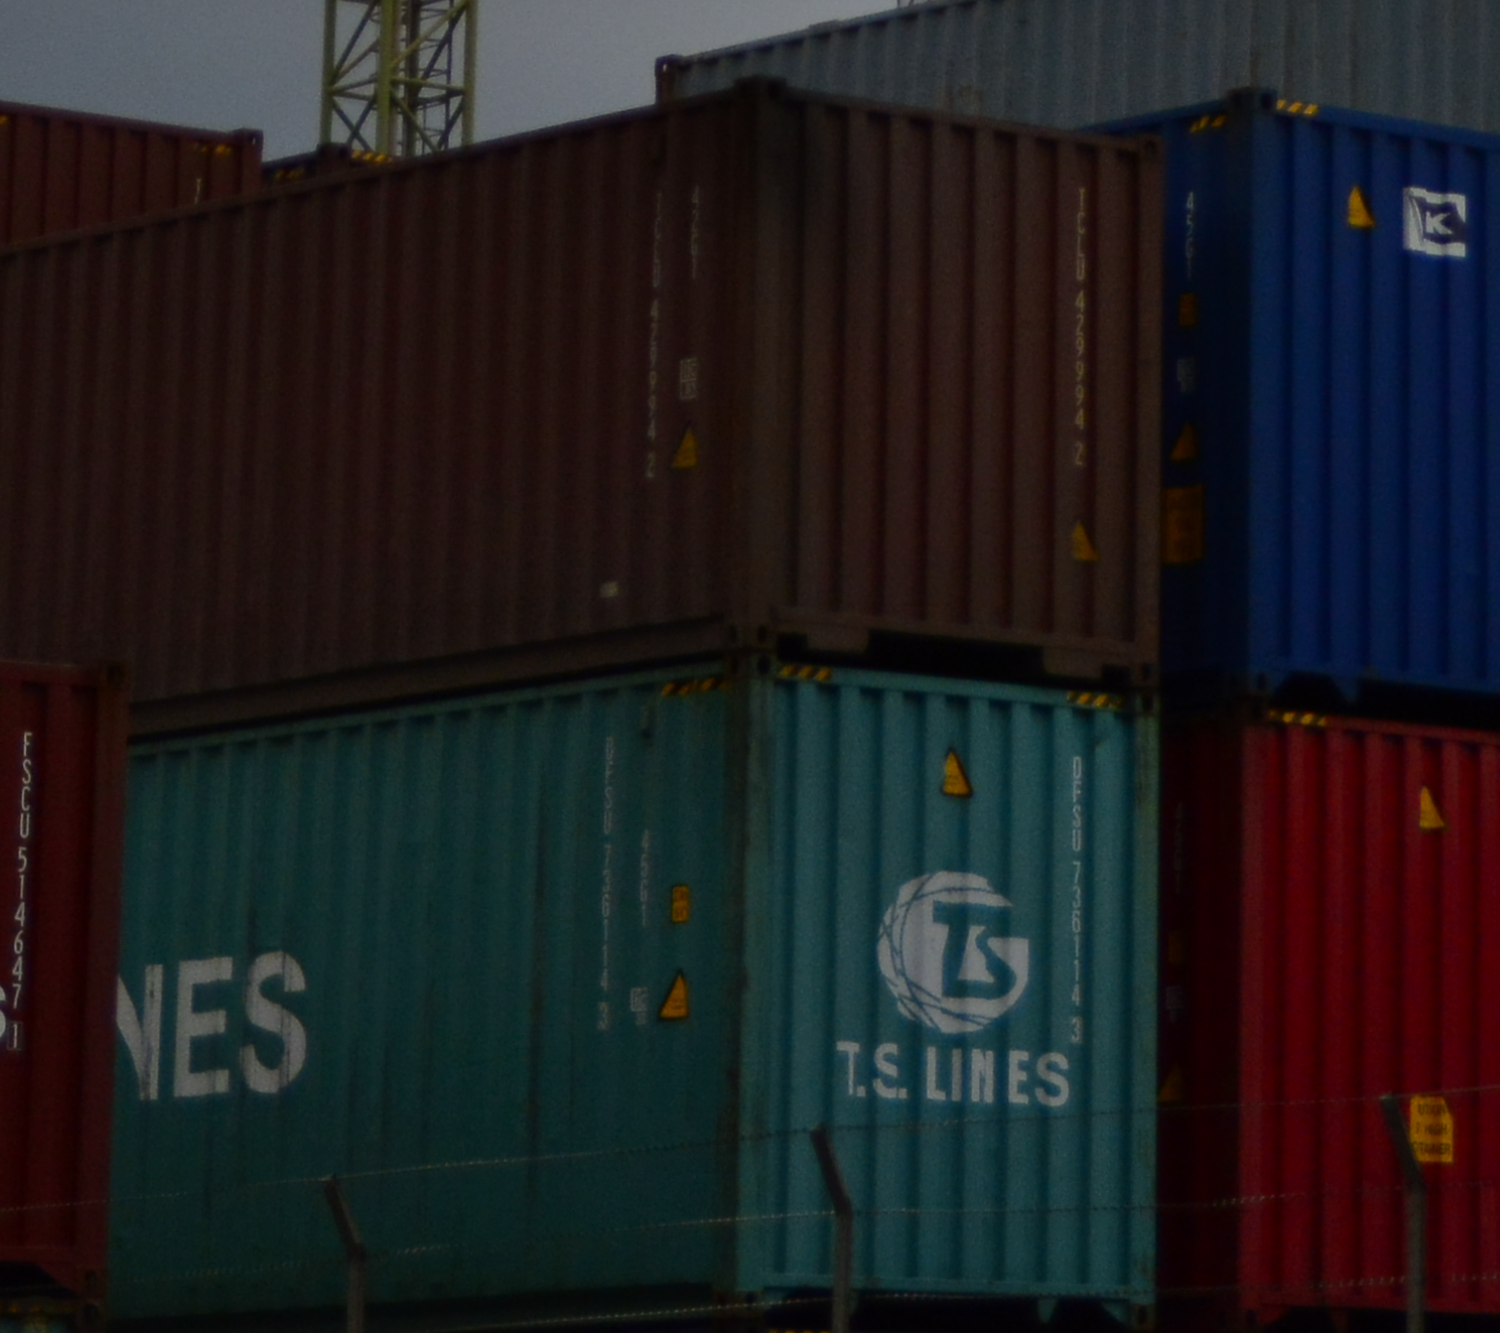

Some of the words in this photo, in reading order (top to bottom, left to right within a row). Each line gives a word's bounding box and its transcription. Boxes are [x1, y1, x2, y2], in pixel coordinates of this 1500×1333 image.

[1074, 290, 1086, 431] 429994
[19, 732, 34, 840] FSCU
[12, 847, 28, 1010] 514647
[836, 1040, 909, 1099] T.S.
[925, 1045, 1070, 1107] LINES
